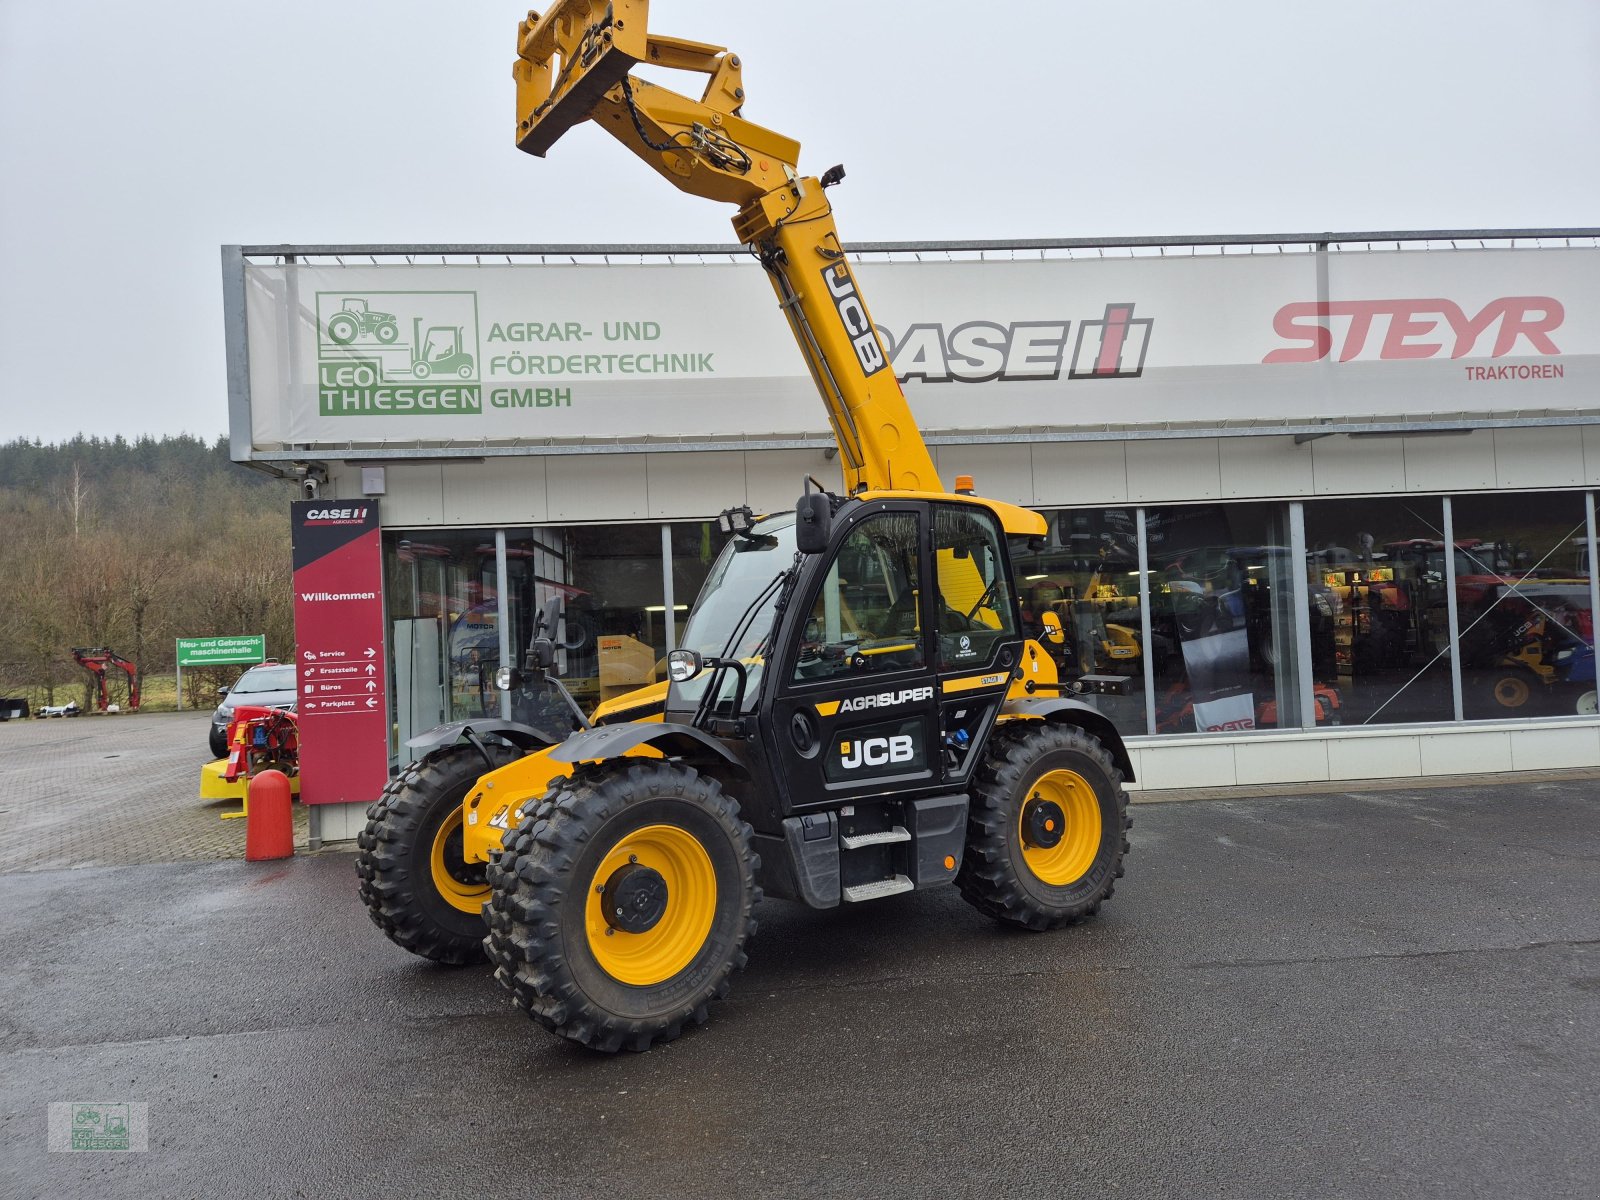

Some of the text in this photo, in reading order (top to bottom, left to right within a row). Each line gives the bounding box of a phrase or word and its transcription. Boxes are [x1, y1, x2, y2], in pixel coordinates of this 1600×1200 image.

[825, 267, 883, 373] JCB
[1261, 296, 1565, 364] STEYR
[487, 321, 661, 342] AGRAR- UND
[873, 320, 1071, 383] ASE
[490, 351, 715, 375] FÖRDERTECHNIK
[1465, 364, 1564, 381] TRAKTOREN
[321, 366, 374, 388] LEO
[320, 388, 479, 410] THIESGEN
[490, 387, 572, 408] GMBH
[306, 508, 352, 520] CASE
[301, 592, 375, 602] Willkommen
[180, 638, 261, 649] Neu- und Gebraucht-
[190, 646, 252, 656] maschinenhalle
[321, 700, 355, 708] Parkplatz
[840, 686, 933, 713] AGRISUPER
[841, 735, 914, 769] JCB
